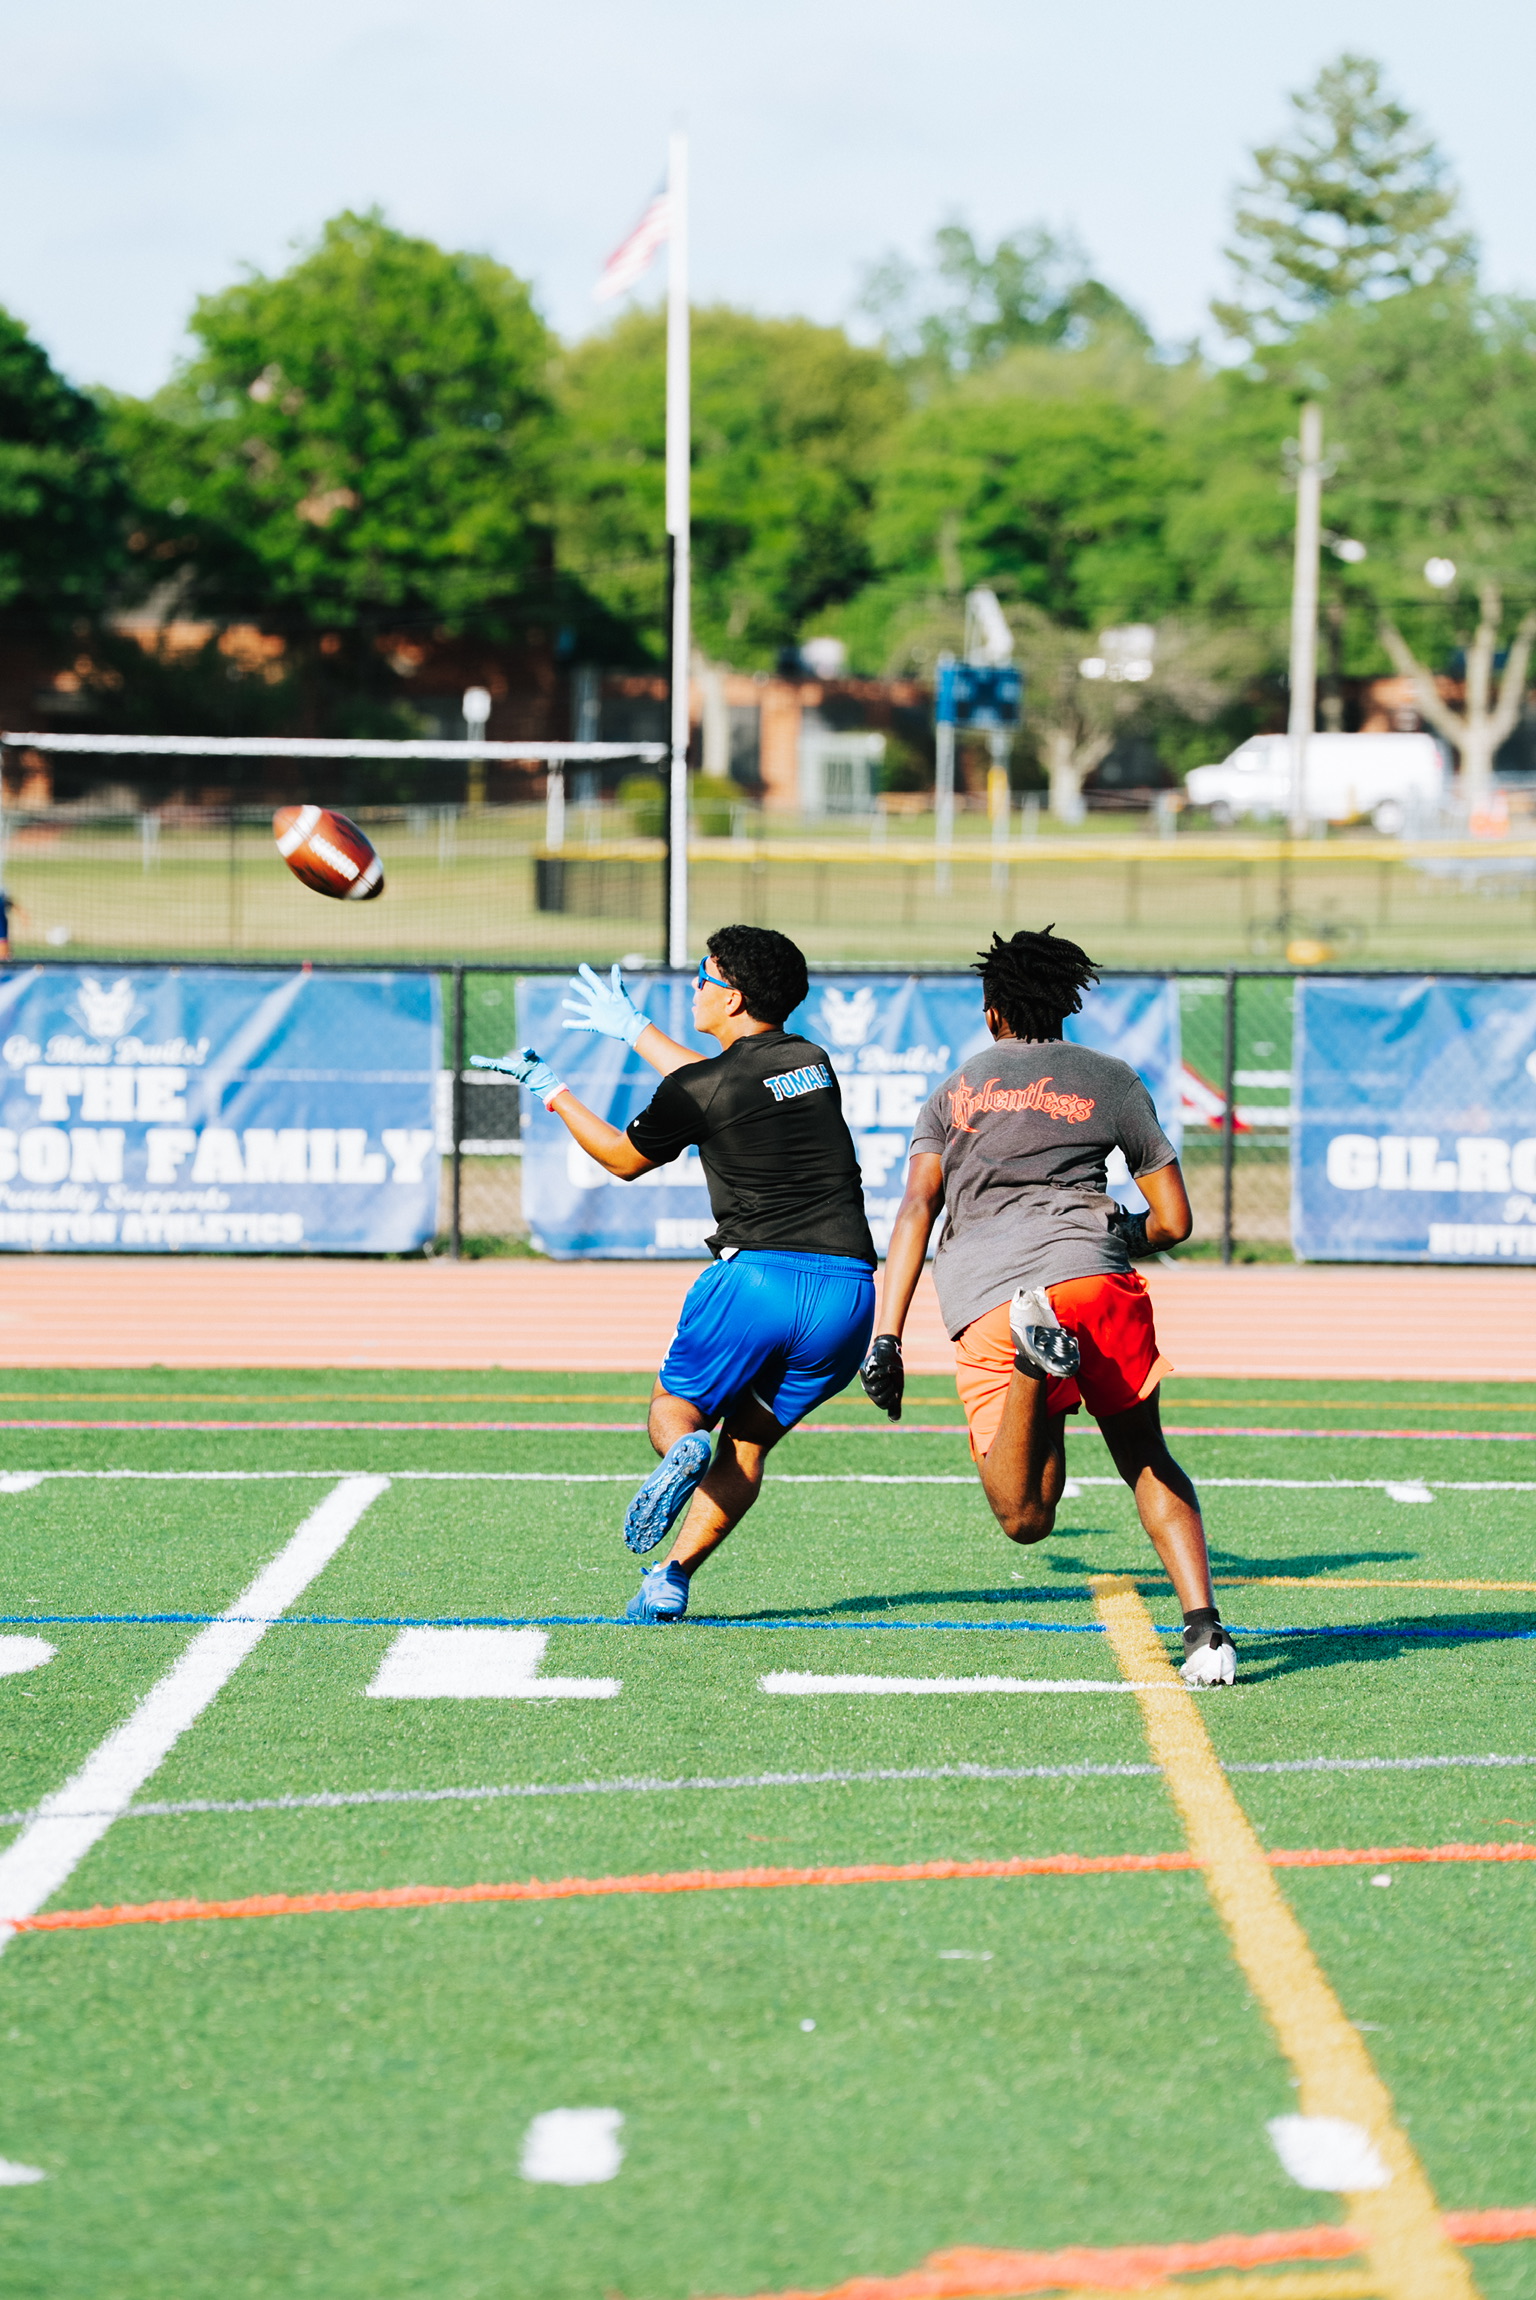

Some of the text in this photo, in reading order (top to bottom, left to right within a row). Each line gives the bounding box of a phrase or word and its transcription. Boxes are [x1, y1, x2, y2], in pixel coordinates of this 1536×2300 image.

[25, 1065, 188, 1122] THE
[830, 1074, 928, 1127] HE
[948, 1074, 1096, 1134] Relentless
[146, 1128, 435, 1184] FAMILY
